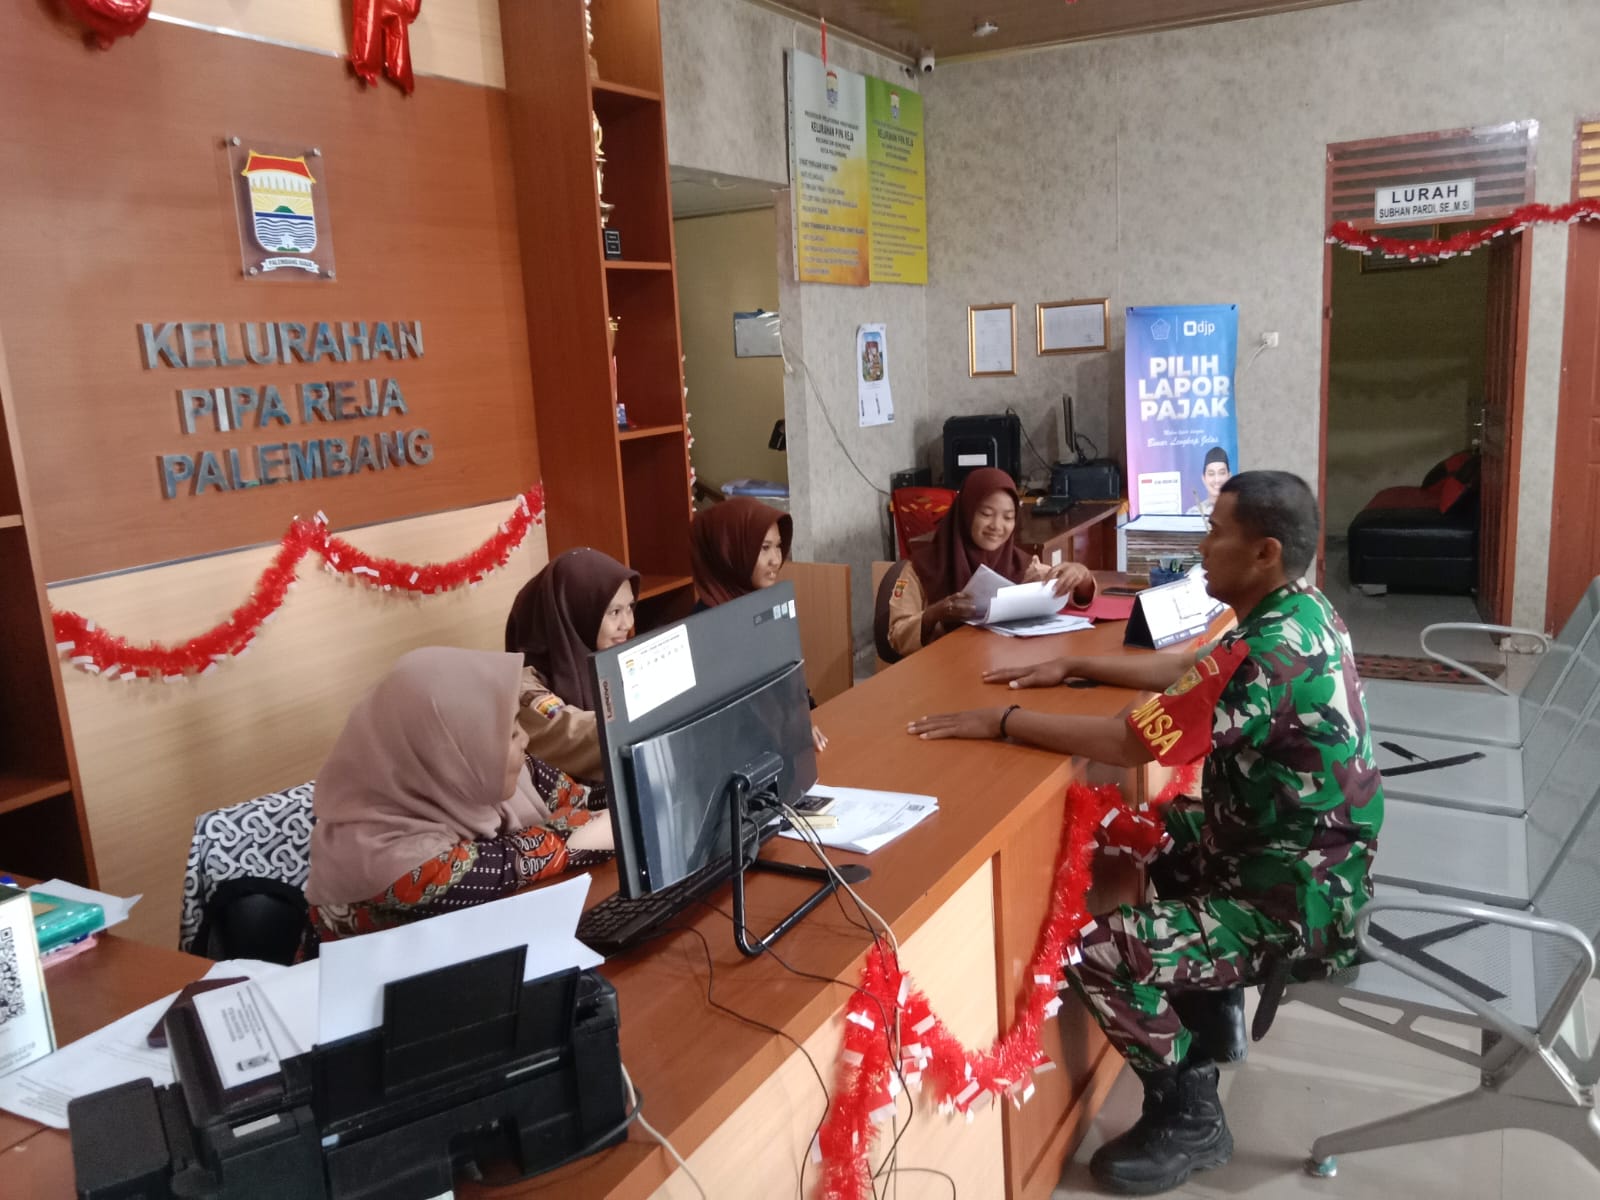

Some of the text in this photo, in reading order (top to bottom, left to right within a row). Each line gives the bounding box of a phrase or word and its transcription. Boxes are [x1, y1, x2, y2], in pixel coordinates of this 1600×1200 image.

[1392, 185, 1458, 204] LURAH
[1379, 207, 1410, 219] SUBHAN
[1197, 320, 1215, 336] djp
[137, 320, 424, 370] KELURAHAN
[1149, 354, 1219, 379] PILIH
[1138, 375, 1230, 400] LAPOR
[177, 378, 408, 434] PIPA REJA
[1140, 397, 1230, 422] PAJAK
[157, 428, 434, 499] PALEMBANG
